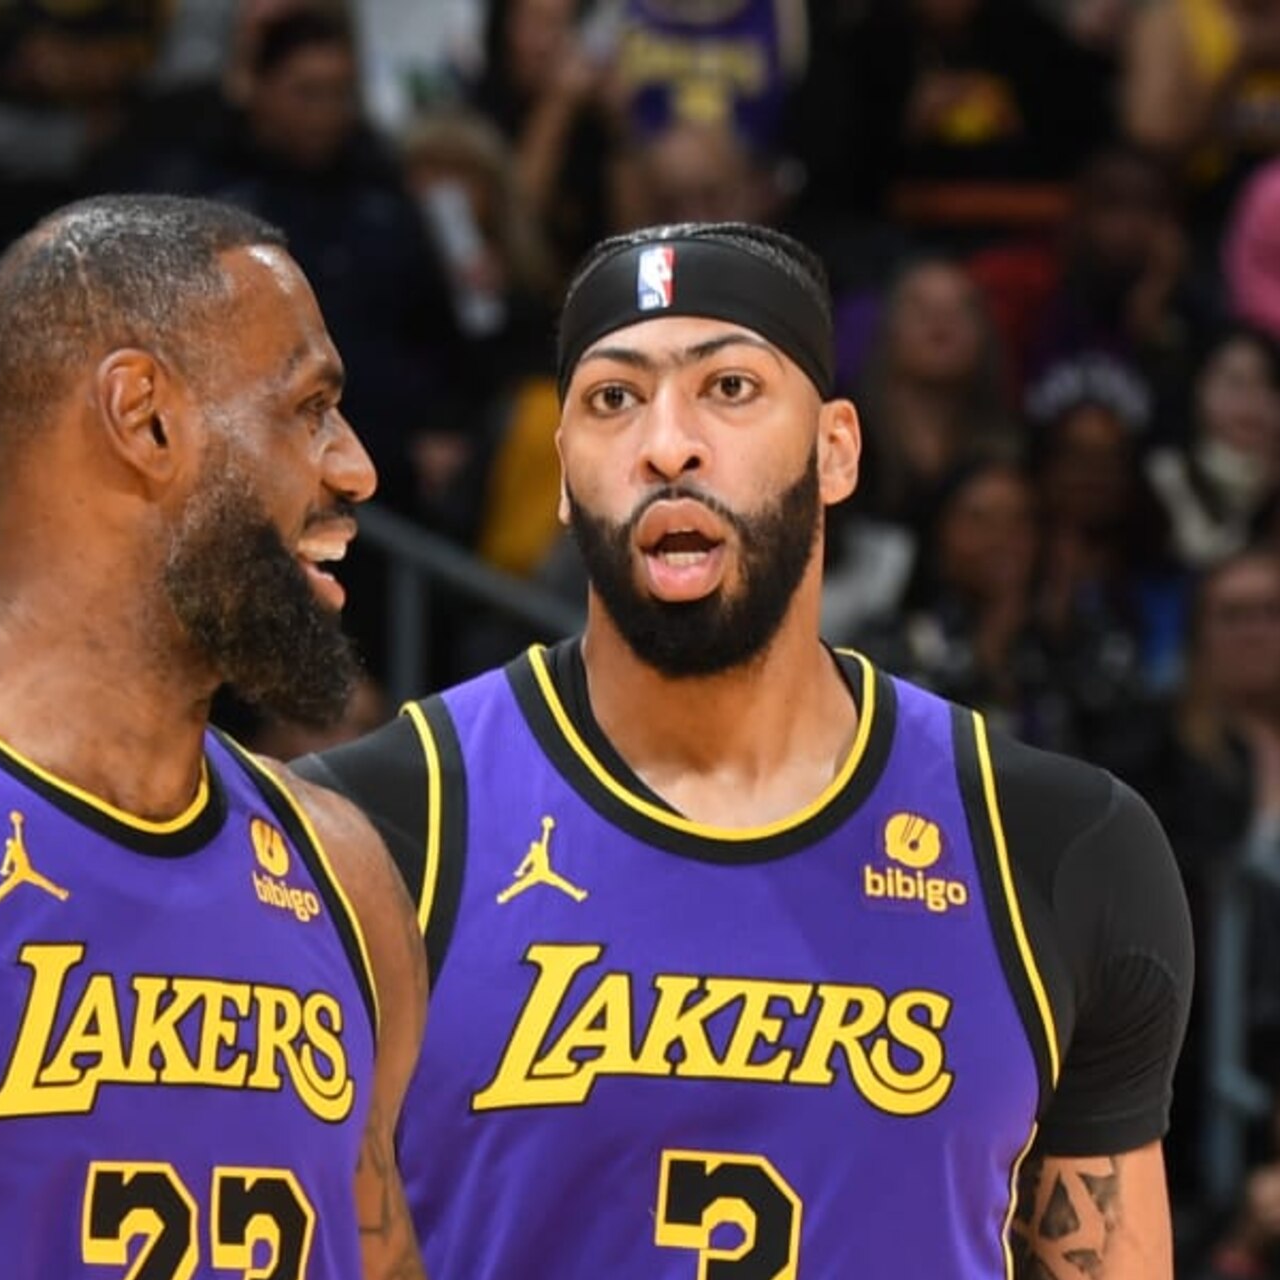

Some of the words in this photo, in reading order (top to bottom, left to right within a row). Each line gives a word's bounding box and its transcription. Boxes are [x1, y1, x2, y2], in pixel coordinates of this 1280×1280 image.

[252, 869, 321, 923] bibigo
[863, 864, 968, 913] bibigo
[472, 942, 954, 1118] LAKERS
